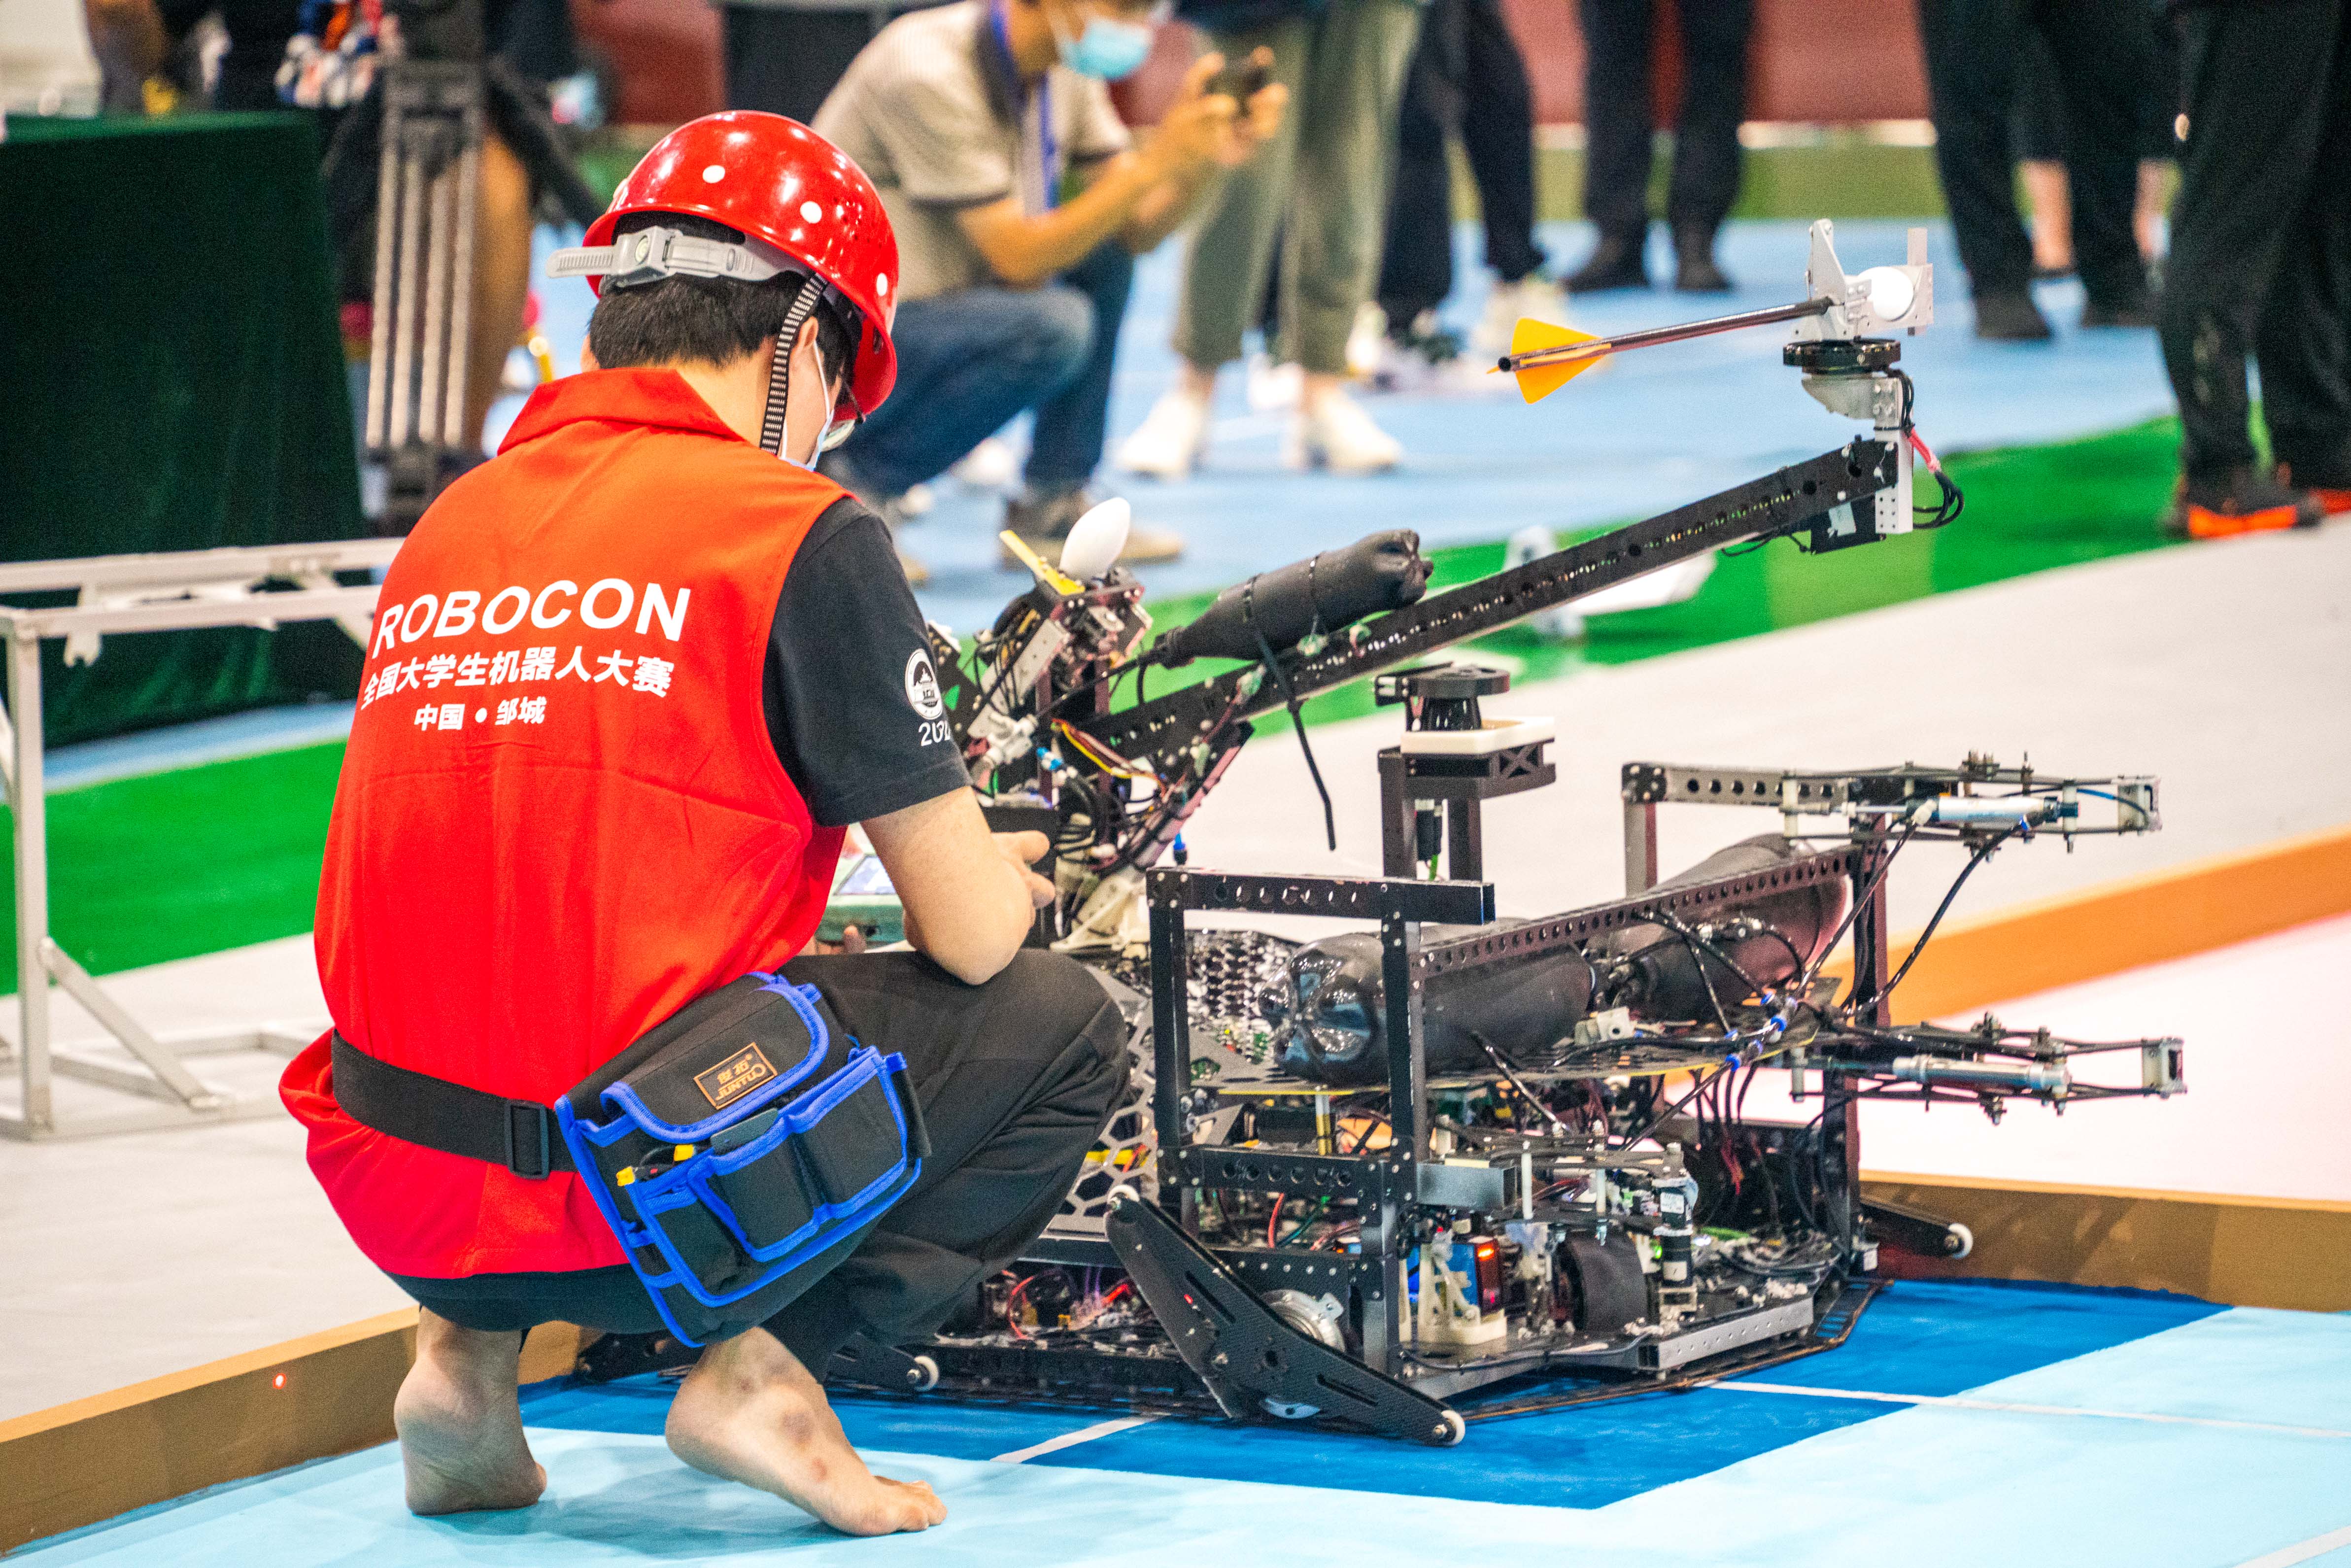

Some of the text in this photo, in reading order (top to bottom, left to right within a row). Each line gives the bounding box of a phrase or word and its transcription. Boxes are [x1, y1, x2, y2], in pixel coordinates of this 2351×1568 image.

[372, 578, 691, 659] ROBOCON
[361, 646, 675, 710] 全国大学生机器人大赛
